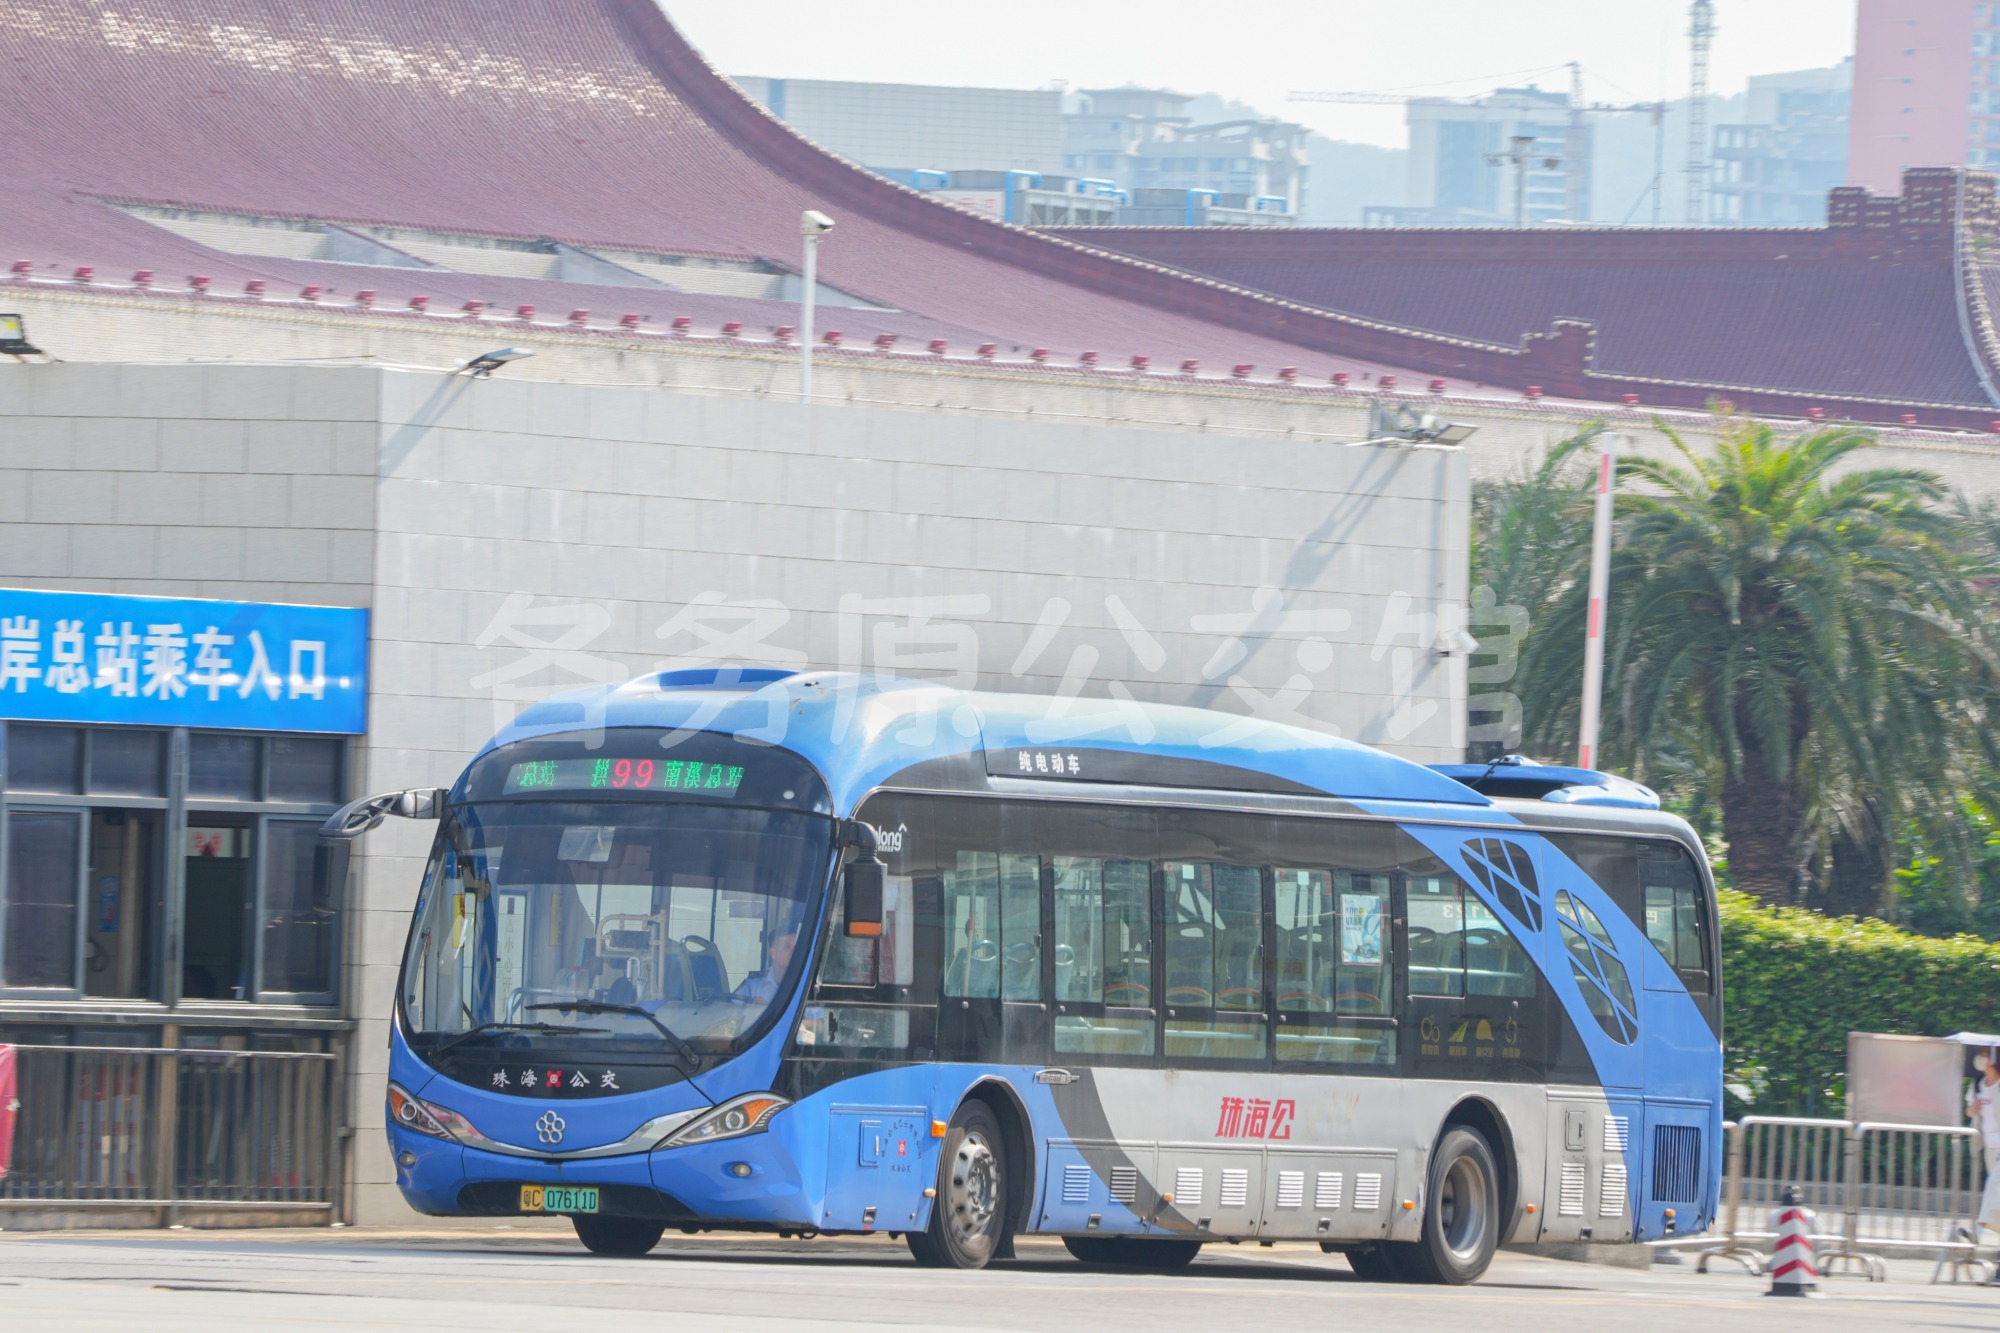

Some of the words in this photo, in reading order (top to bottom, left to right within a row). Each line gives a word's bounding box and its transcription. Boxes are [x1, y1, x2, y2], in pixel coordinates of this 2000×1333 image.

[0, 615, 327, 701] 岸总站乘车入口
[613, 758, 655, 788] 99
[1018, 750, 1080, 775] 纯电动车
[1214, 1096, 1296, 1140] 珠海公
